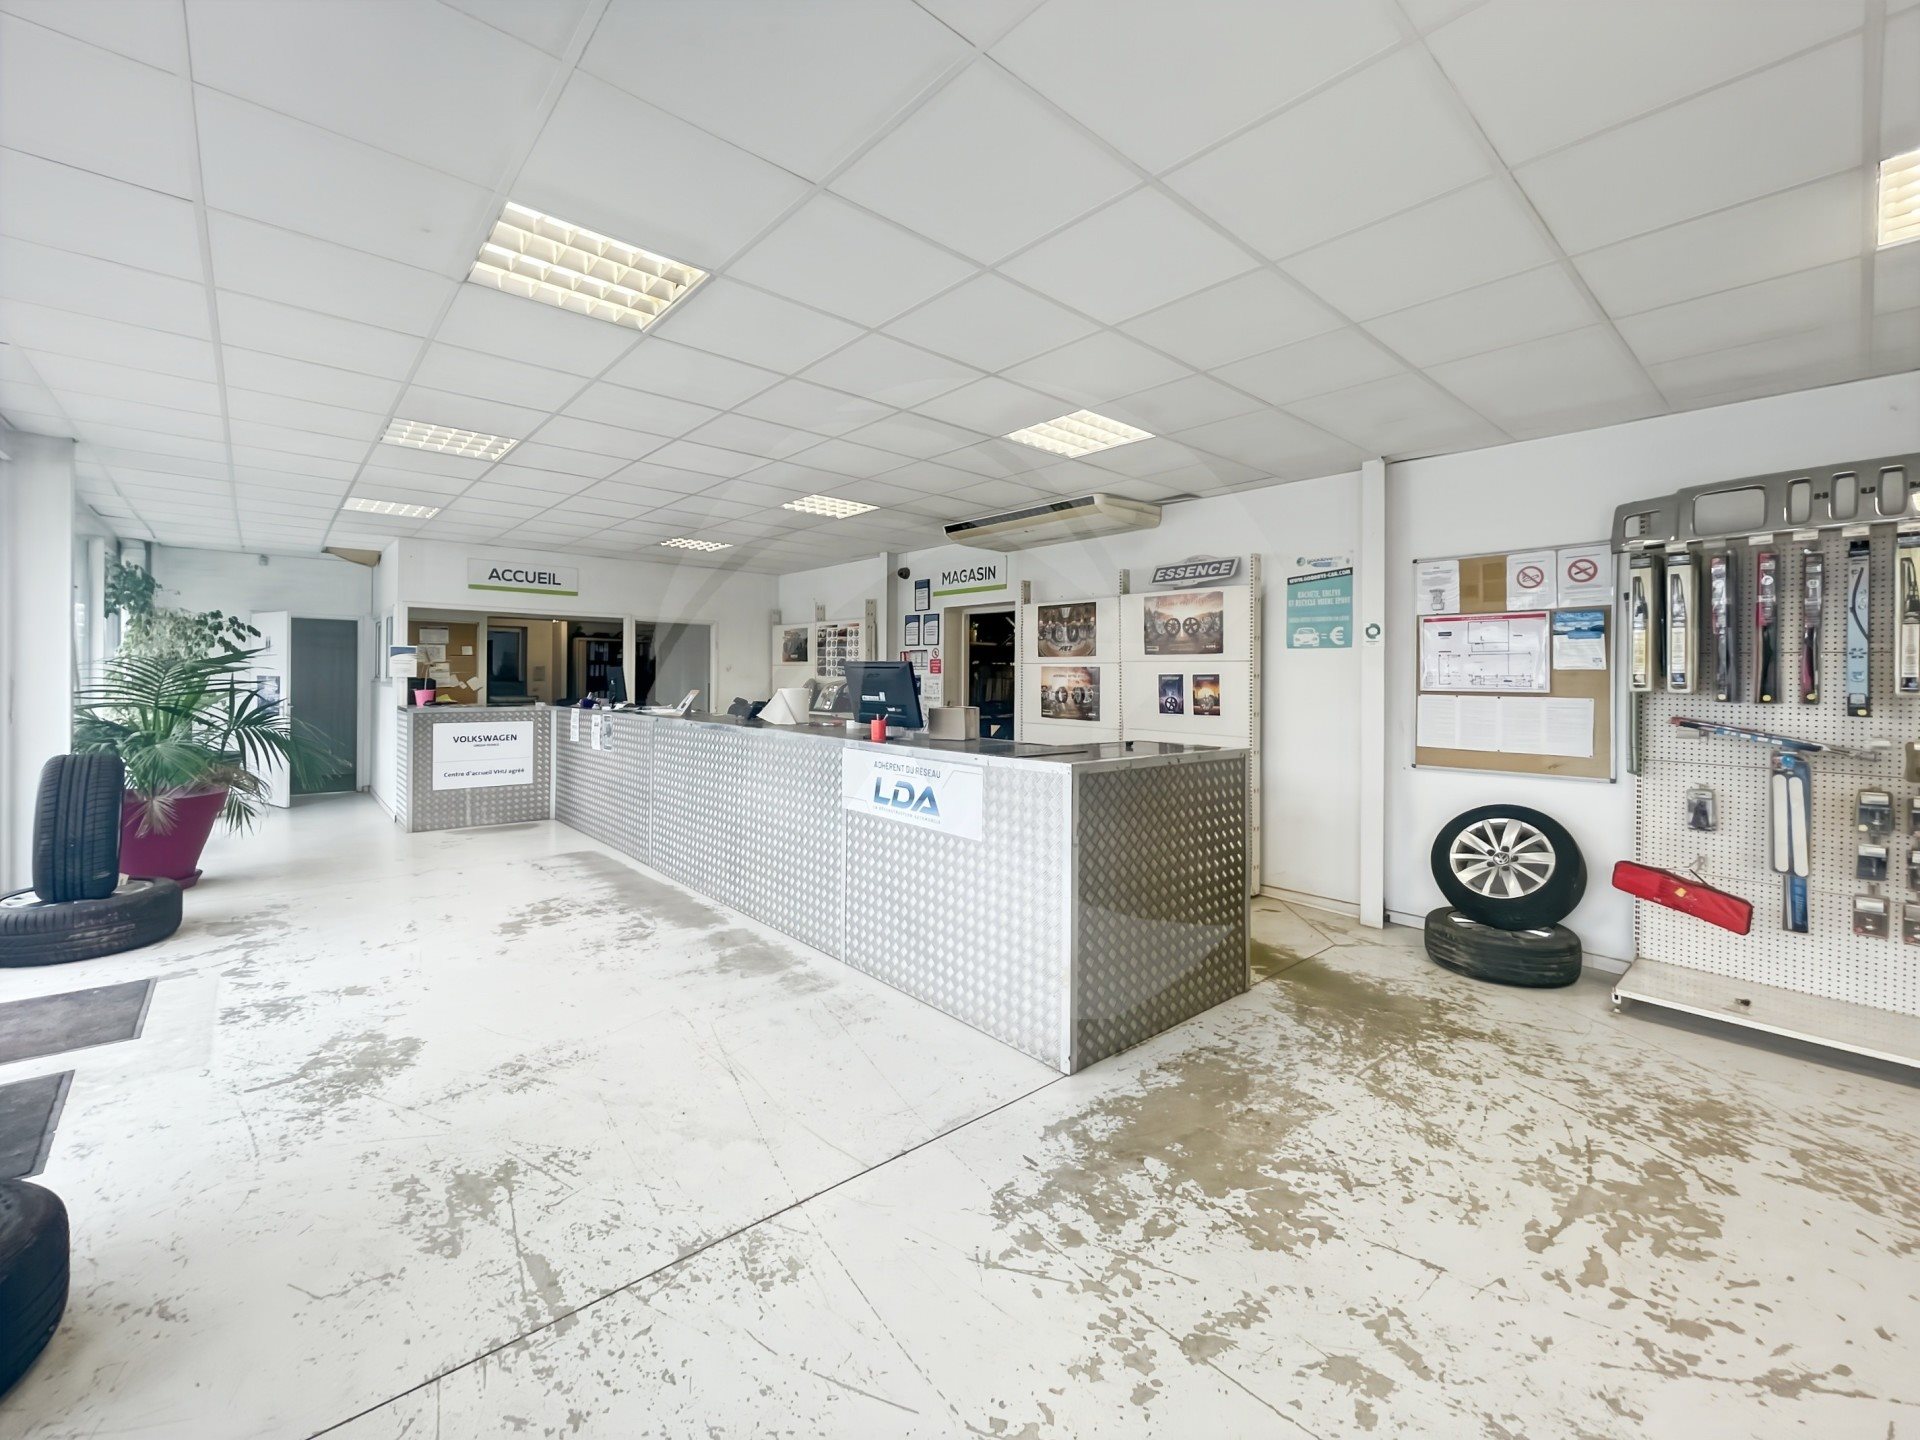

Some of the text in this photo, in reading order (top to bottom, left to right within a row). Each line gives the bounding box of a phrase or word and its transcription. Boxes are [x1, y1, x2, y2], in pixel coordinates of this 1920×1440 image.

[488, 568, 562, 586] ACCUEIL
[941, 566, 996, 586] MAGASIN
[1155, 562, 1232, 581] ESSENCE
[453, 734, 517, 743] VOLKSWAGEN
[906, 765, 914, 775] DU
[873, 776, 941, 817] LDA
